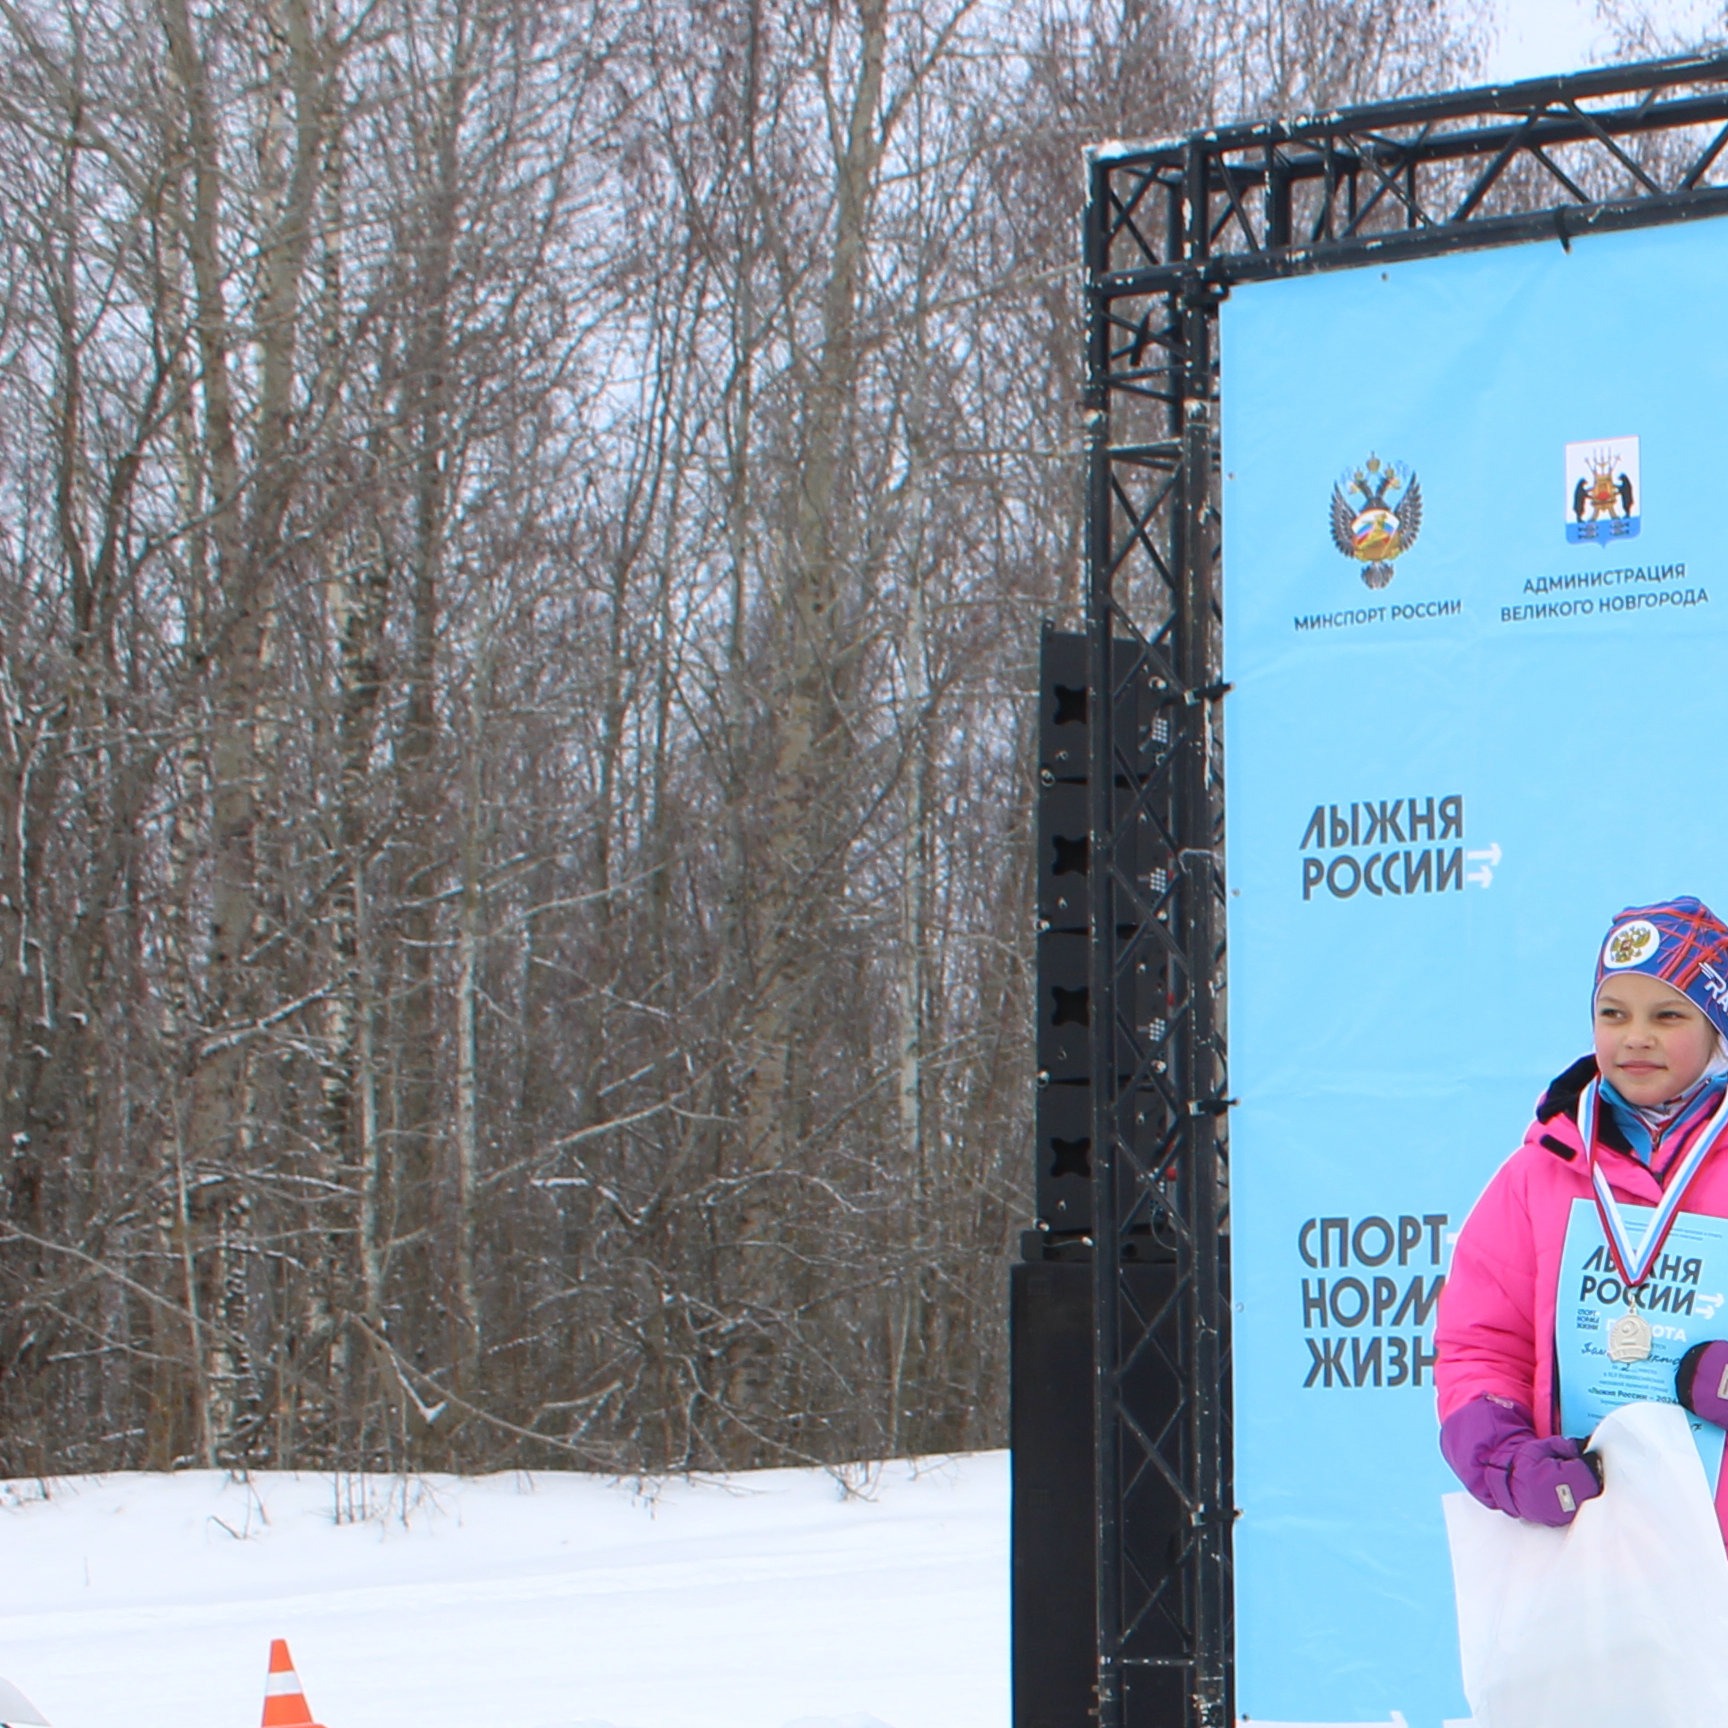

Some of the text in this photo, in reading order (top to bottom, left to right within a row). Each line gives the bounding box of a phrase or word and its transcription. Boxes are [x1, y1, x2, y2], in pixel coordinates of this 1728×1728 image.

[1500, 588, 1709, 623] ВЕЛИКОГО НОВГОРОДА
[1523, 563, 1686, 595] АДМИНИСТРАЦИЯ
[1294, 599, 1462, 632] МИНСПОРТ РОССИИ
[1299, 795, 1463, 850] ЛЫЖНЯ
[1303, 846, 1463, 901] РОССИИ
[1298, 1214, 1448, 1269] СПОРТ
[1301, 1275, 1446, 1328] НОРМ
[1303, 1335, 1438, 1388] ЖИЗН
